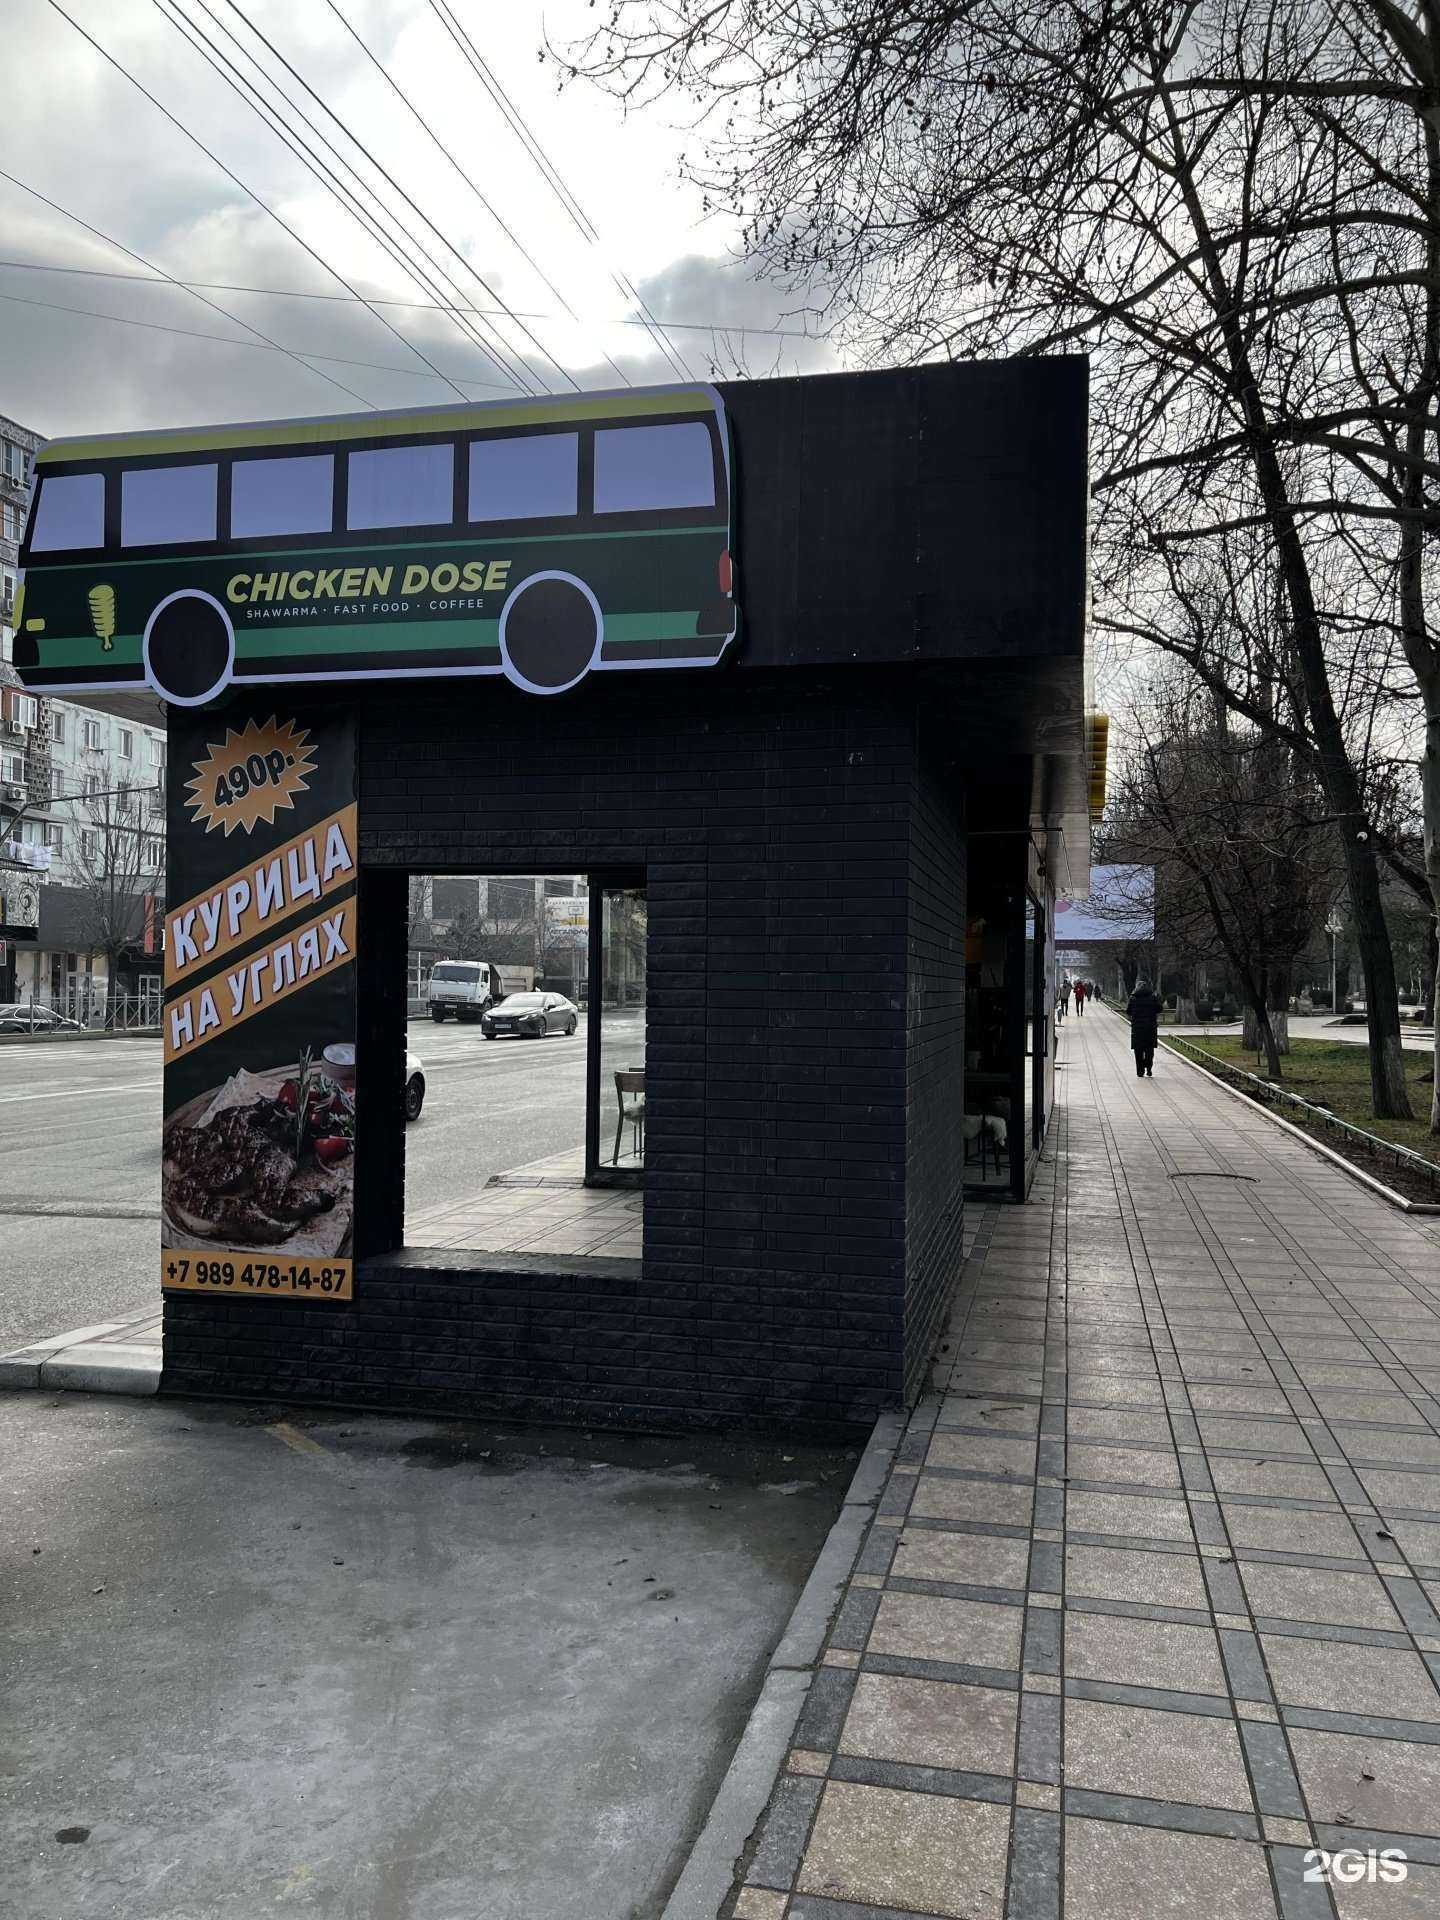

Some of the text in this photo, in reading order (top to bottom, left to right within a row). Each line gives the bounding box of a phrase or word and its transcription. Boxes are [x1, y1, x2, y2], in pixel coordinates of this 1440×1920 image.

[226, 560, 512, 604] CHICKEN DOSE
[246, 598, 484, 619] SHAWARMA FAST FOOD COFFEE
[213, 749, 296, 808] 490р.
[172, 823, 353, 969] КУРИЦА
[170, 911, 350, 1051] НА УГЛЯХ
[167, 1260, 346, 1292] +7 989 478-14-87
